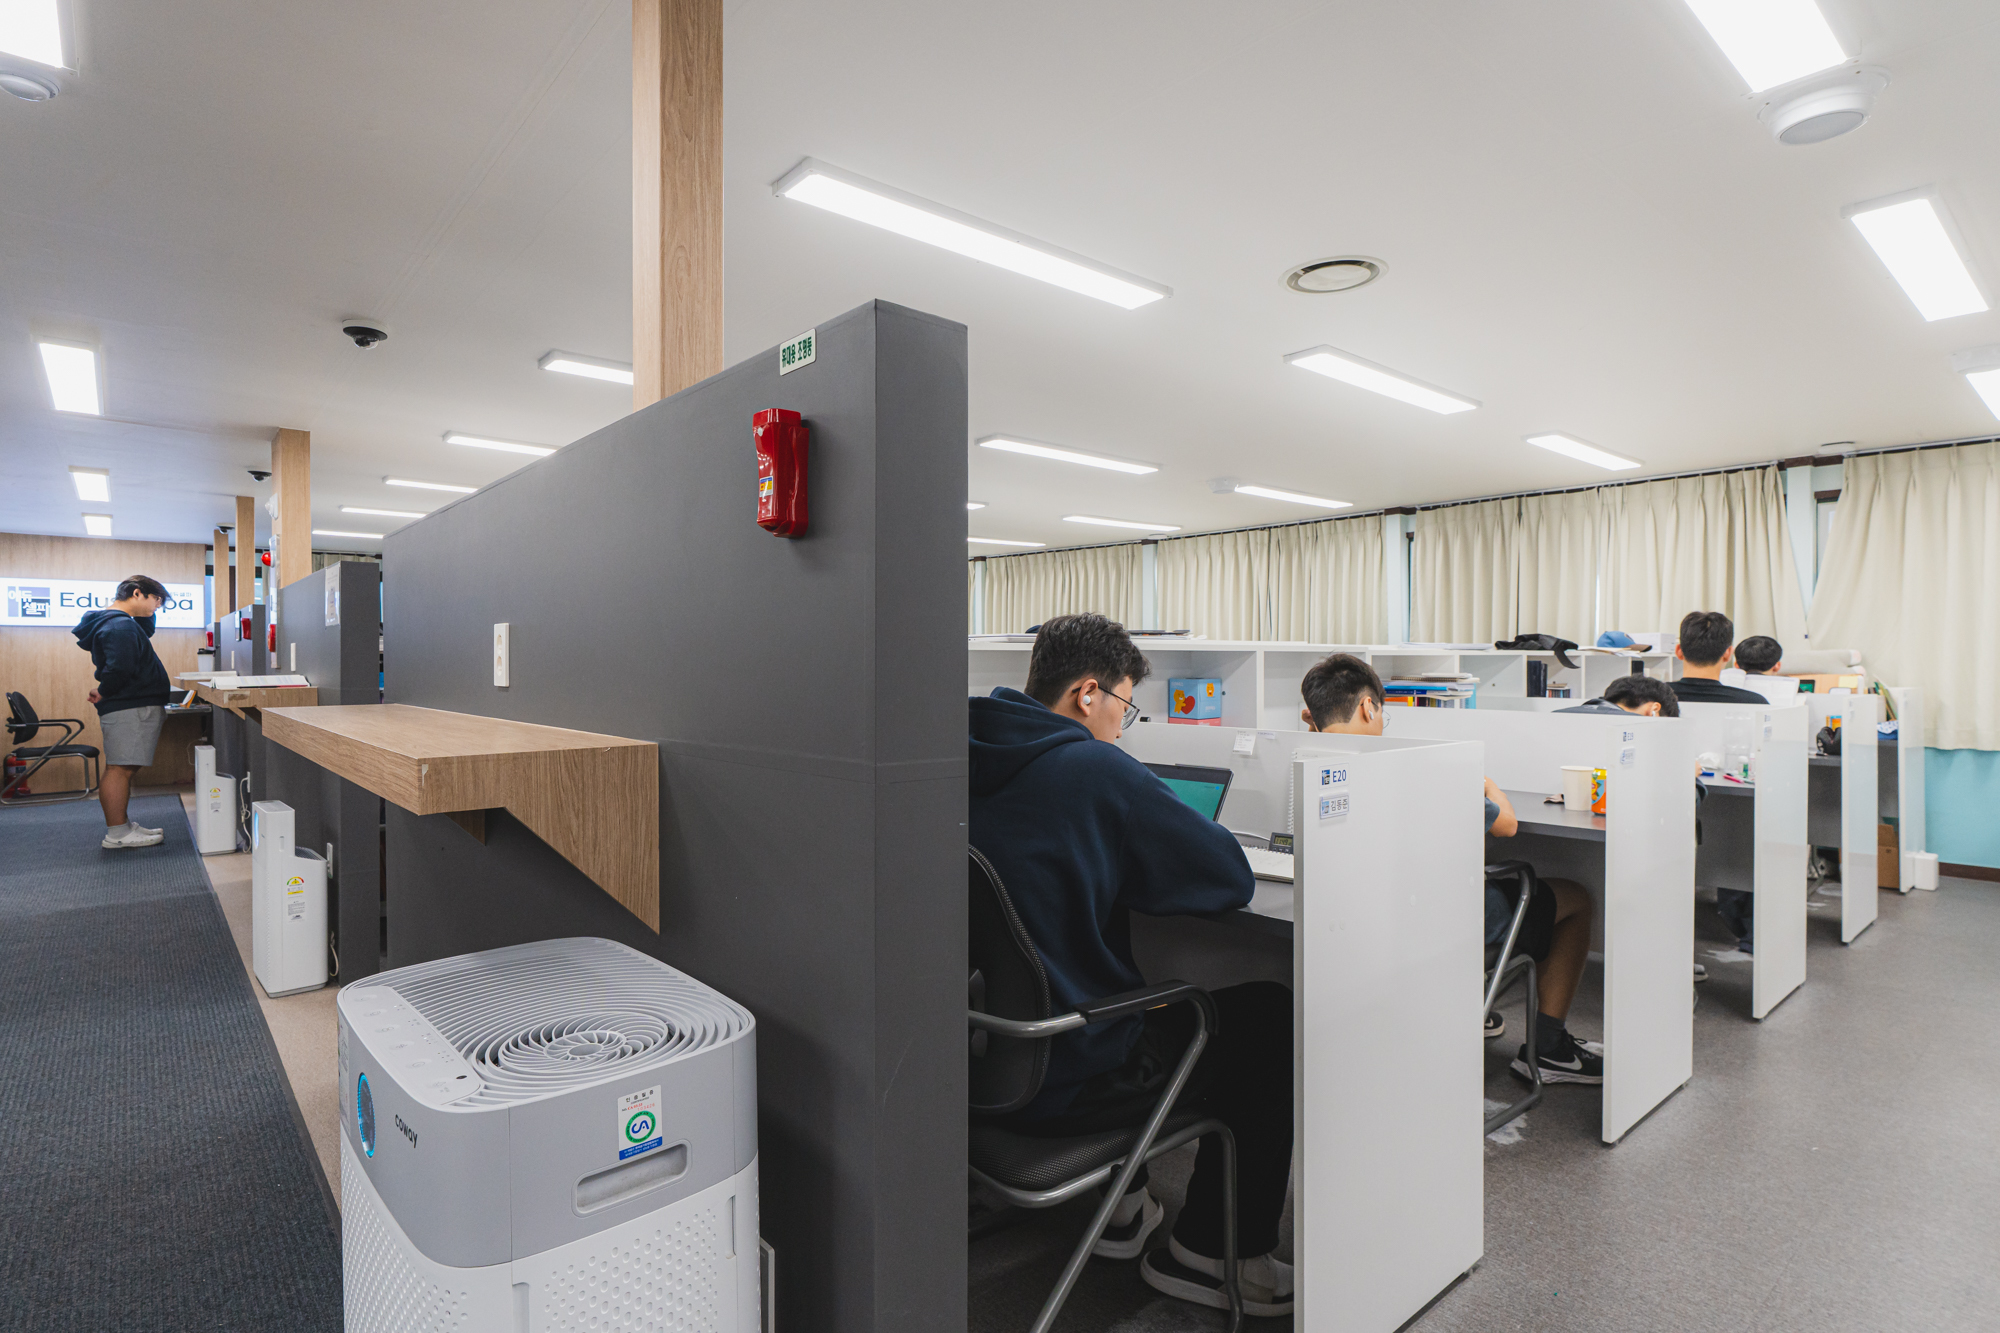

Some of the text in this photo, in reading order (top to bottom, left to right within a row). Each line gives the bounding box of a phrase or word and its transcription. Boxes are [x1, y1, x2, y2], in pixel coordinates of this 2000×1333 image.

[782, 336, 812, 368] 휴대용 조명등
[23, 602, 50, 616] 셀파
[60, 592, 193, 613] Edupa
[1332, 770, 1346, 782] E20
[394, 1113, 418, 1149] coway
